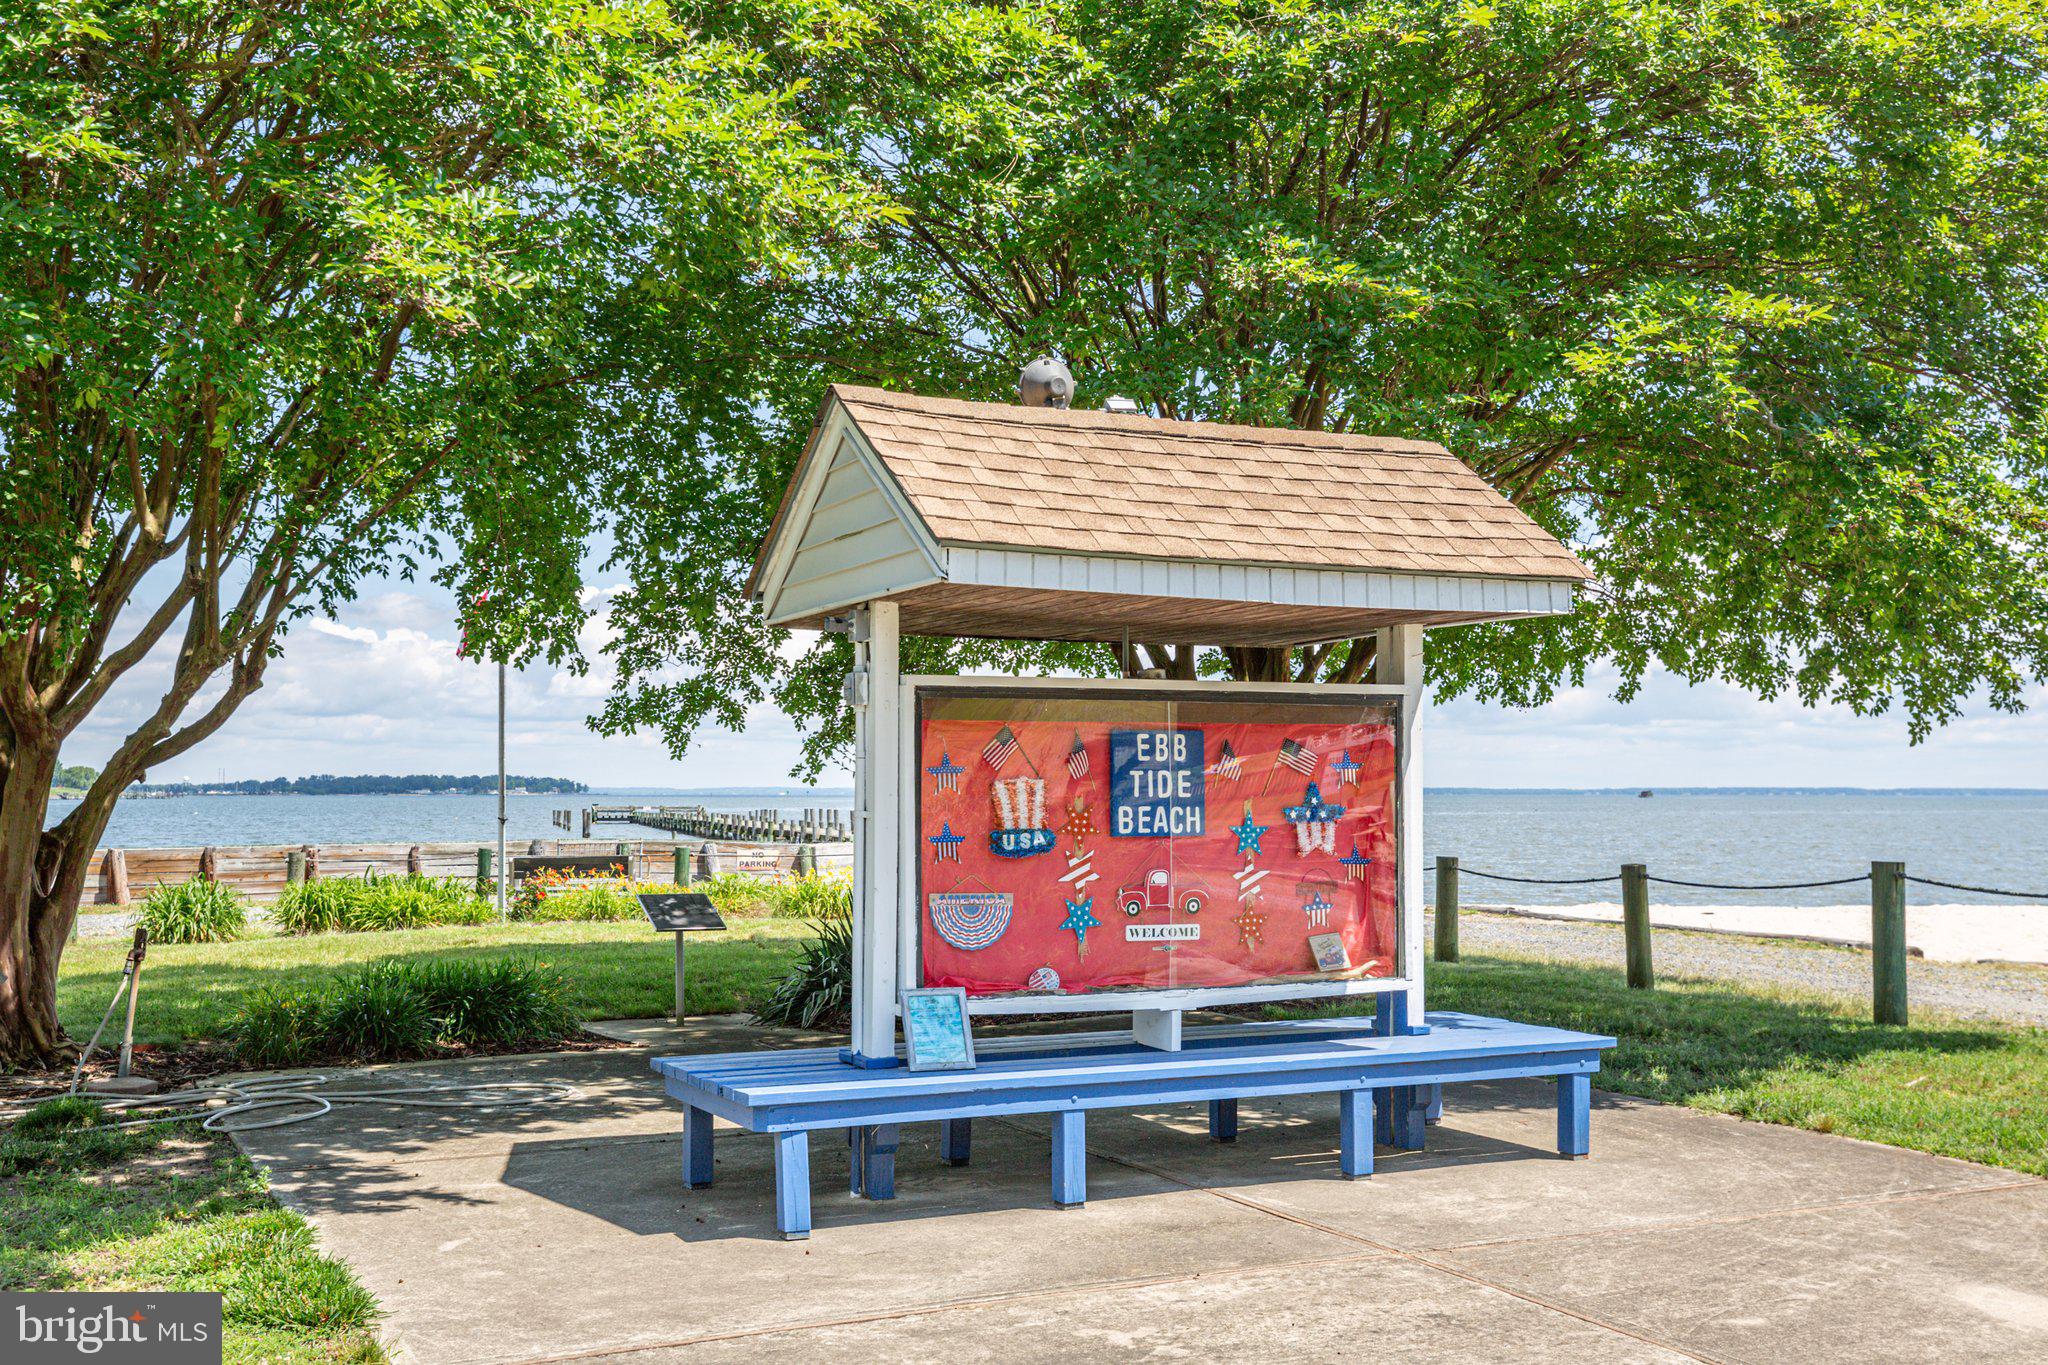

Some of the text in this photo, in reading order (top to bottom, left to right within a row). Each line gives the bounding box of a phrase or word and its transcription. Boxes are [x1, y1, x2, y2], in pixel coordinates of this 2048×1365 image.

[1136, 733, 1187, 762] EBB
[1129, 770, 1192, 798] TIDE
[1118, 806, 1201, 834] BEACH
[1002, 830, 1047, 850] USA
[936, 894, 1005, 905] AMERICA
[1129, 927, 1199, 938] WELCOME
